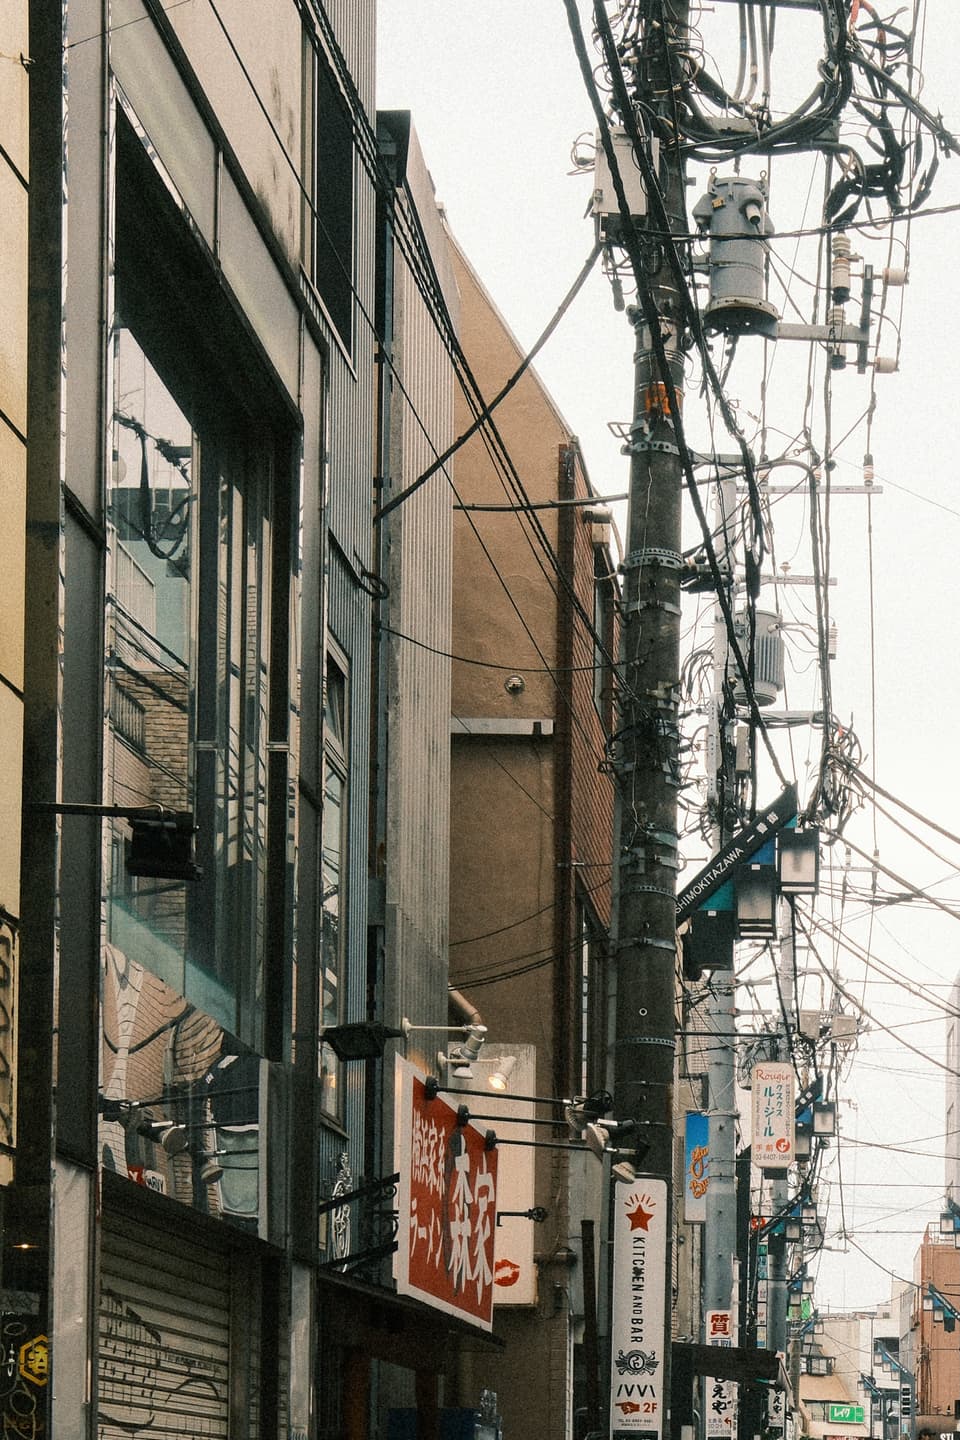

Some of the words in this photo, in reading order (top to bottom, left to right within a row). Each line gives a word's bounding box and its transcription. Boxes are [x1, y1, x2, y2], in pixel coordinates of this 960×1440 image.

[675, 846, 744, 915] SHIMOKITAZAWA
[755, 1069, 791, 1084] Rougir
[763, 1086, 775, 1137] ルージール
[411, 1196, 444, 1269] ラーメン
[631, 1236, 646, 1292] KITCHEN
[632, 1295, 643, 1315] AND
[630, 1317, 644, 1344] BAR
[710, 1313, 730, 1335] 質
[642, 1402, 658, 1414] 2F
